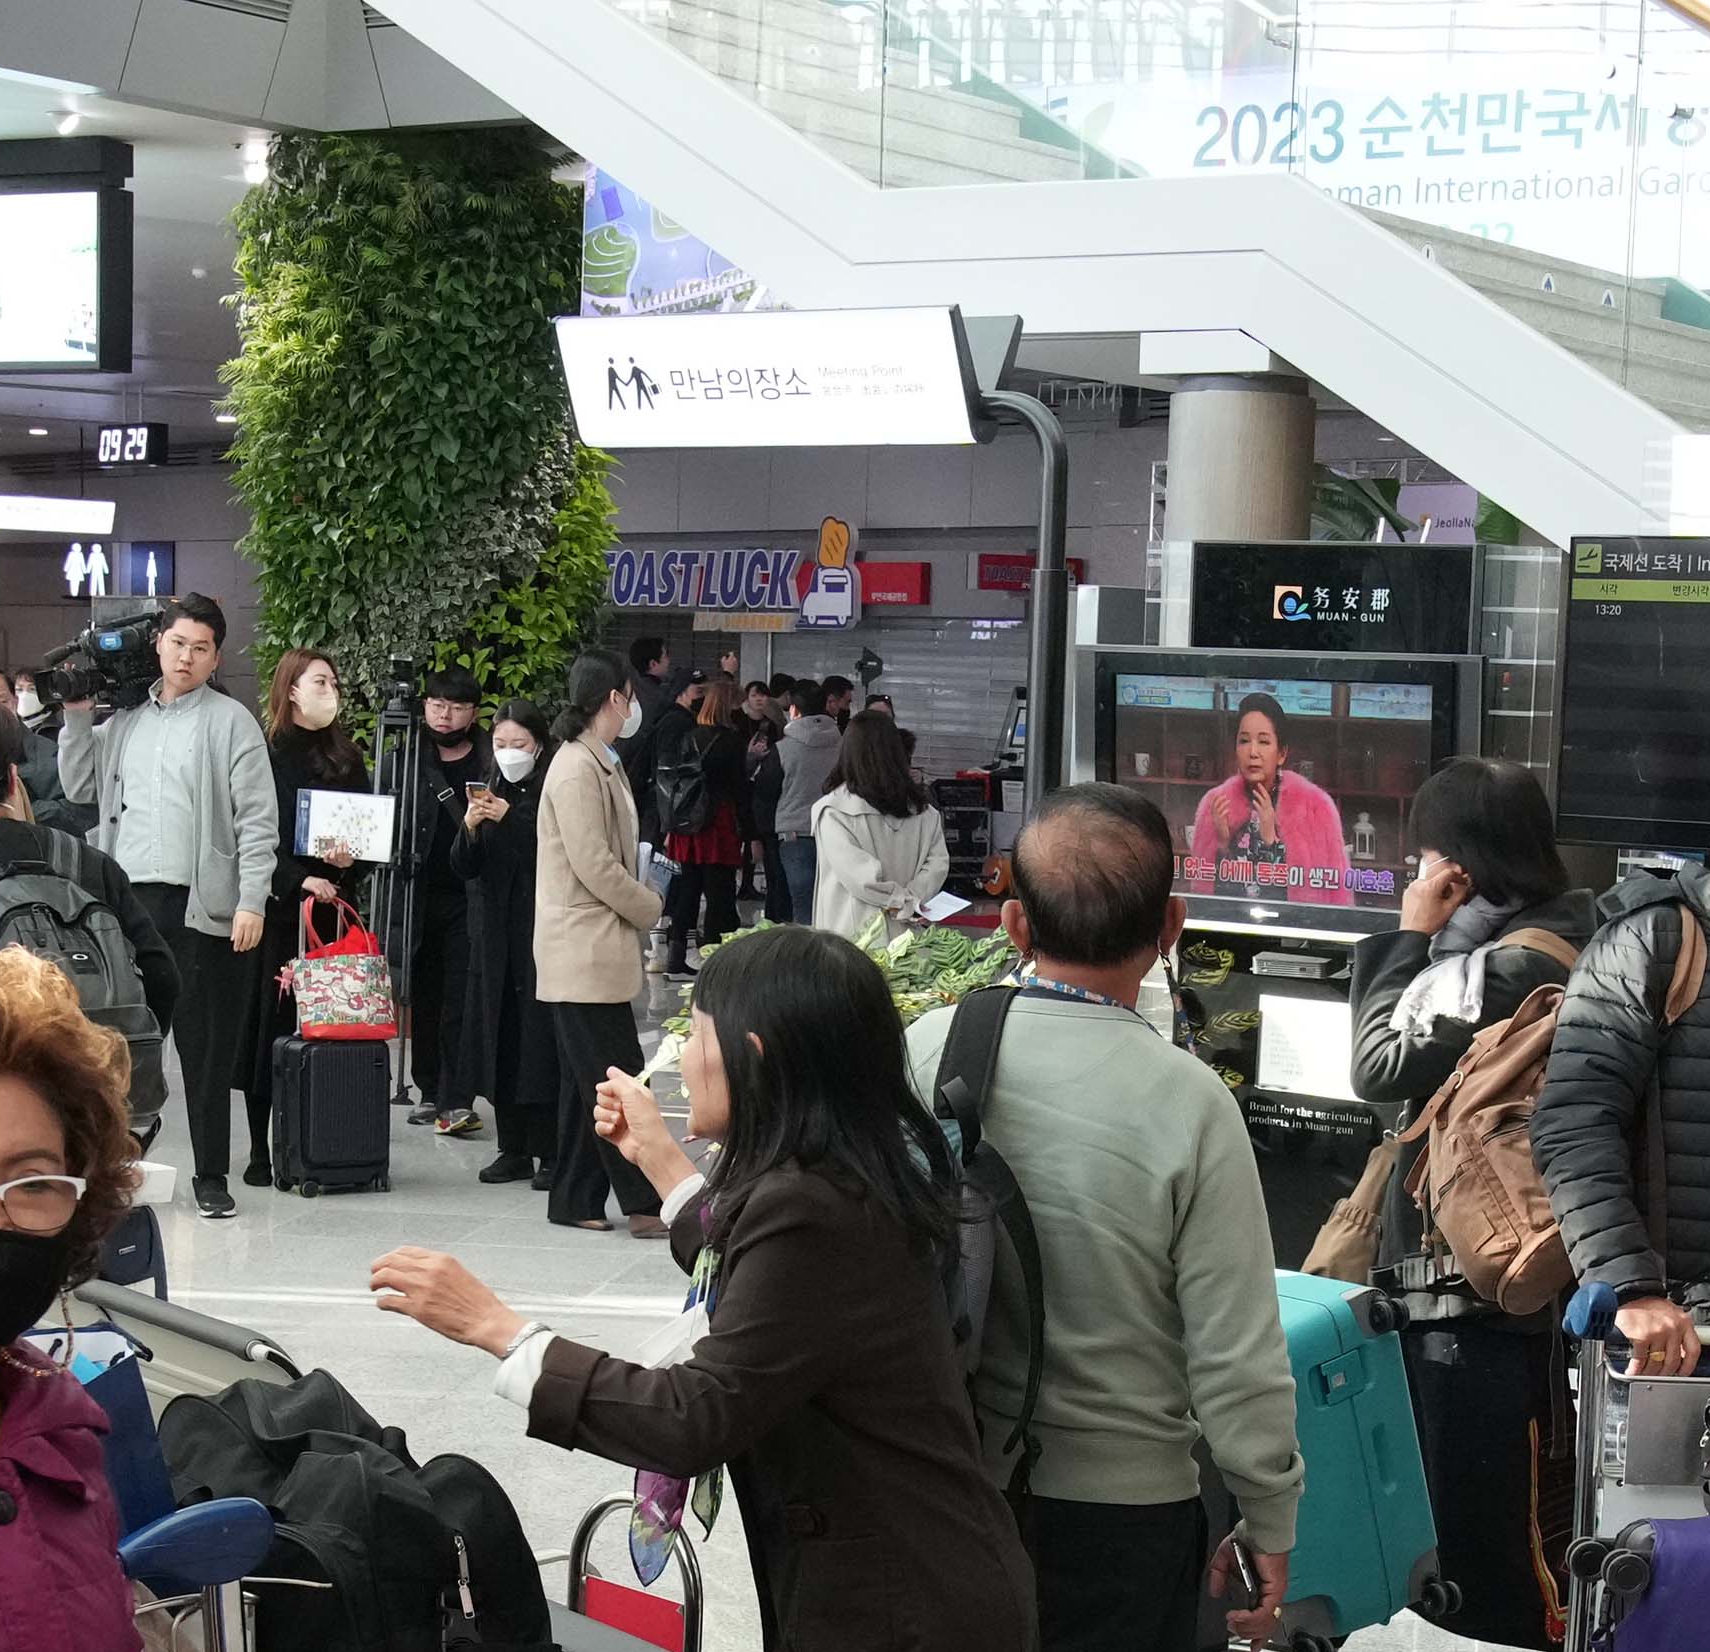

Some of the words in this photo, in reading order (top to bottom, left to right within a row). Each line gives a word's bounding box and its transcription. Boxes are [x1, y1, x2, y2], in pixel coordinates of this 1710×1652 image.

[1193, 101, 1344, 167] 2023
[1416, 165, 1624, 204] International
[871, 364, 903, 377] Point
[669, 368, 811, 400] 만남의장소
[1603, 553, 1648, 573] 국제선
[1651, 554, 1683, 573] 도착
[698, 549, 800, 608] LUCK
[1599, 584, 1618, 595] 시각
[1594, 604, 1622, 616] 13:20
[1183, 856, 1216, 881] 없는
[1218, 858, 1253, 884] 어깨
[1256, 863, 1303, 887] 통증이
[1308, 867, 1339, 890] 생긴
[1343, 868, 1395, 895] 이효춘
[1248, 1115, 1289, 1128] products
[1291, 1119, 1302, 1129] in
[1305, 1121, 1354, 1135] Muan-gun
[1249, 1101, 1277, 1114] Brand
[1280, 1104, 1294, 1116] for
[1296, 1106, 1313, 1118] the
[1315, 1111, 1373, 1125] agricultural
